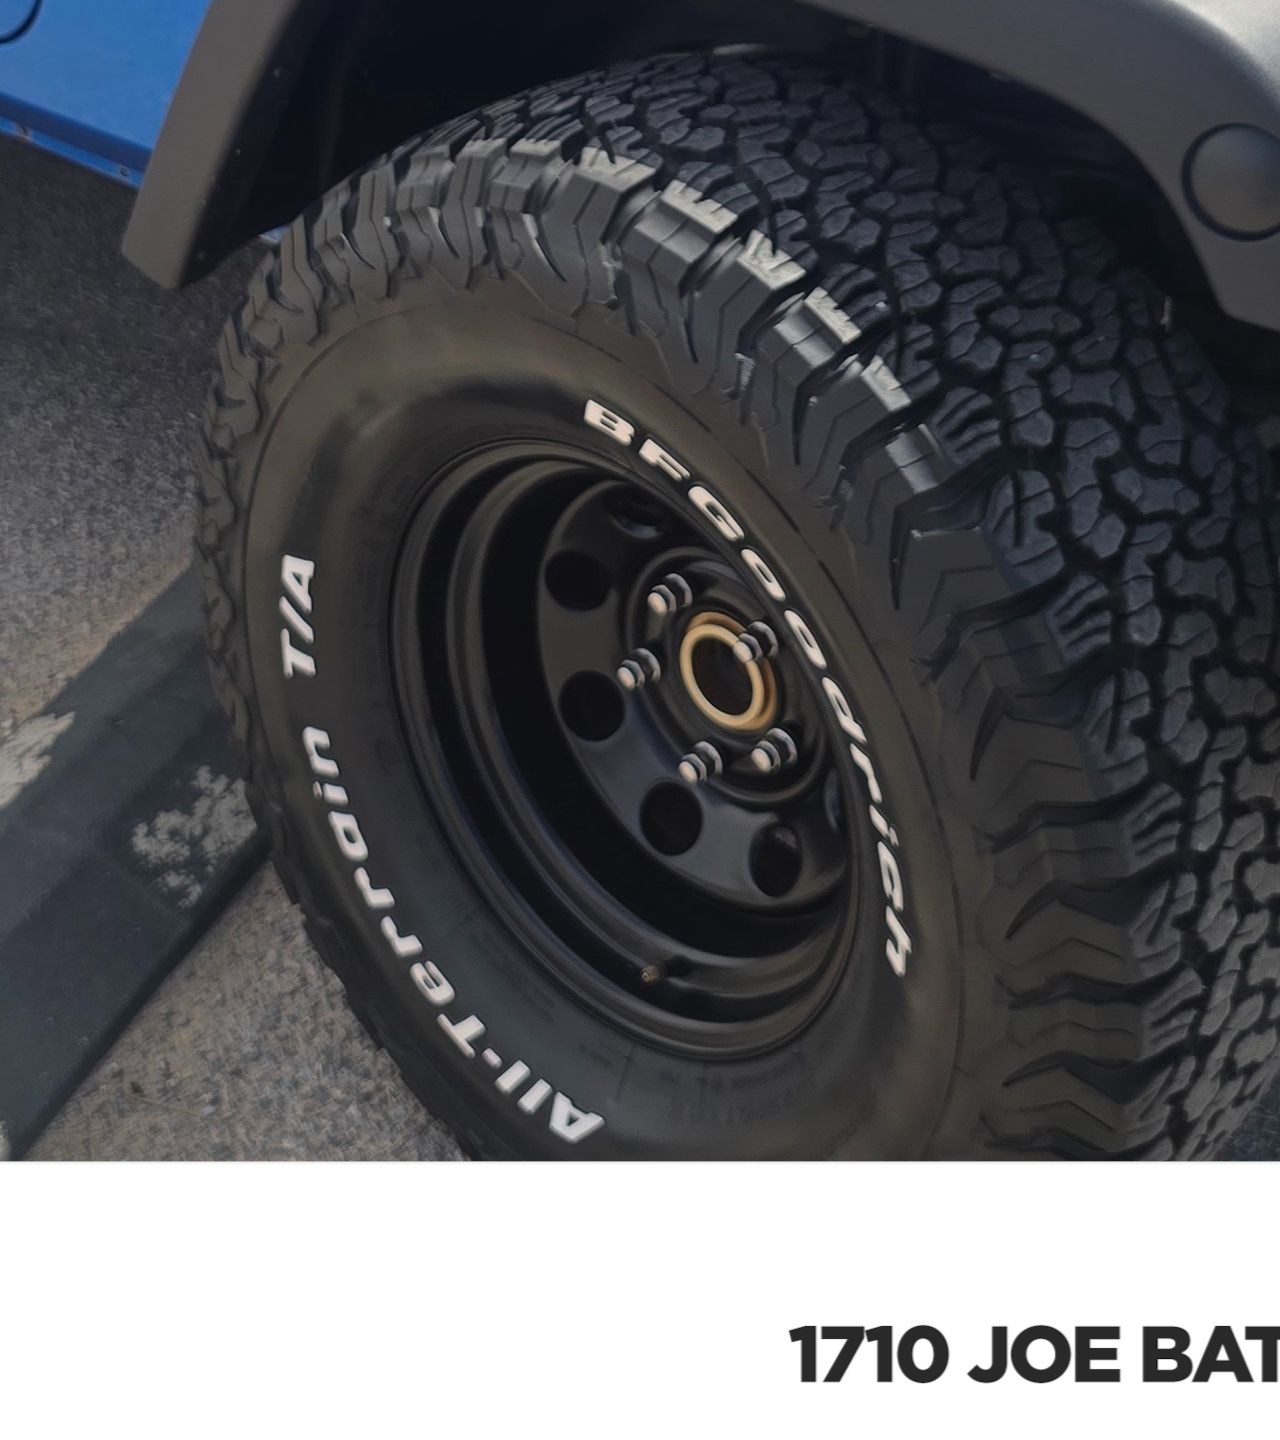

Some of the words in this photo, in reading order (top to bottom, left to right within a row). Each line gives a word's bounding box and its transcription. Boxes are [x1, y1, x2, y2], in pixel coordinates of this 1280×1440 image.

[279, 553, 317, 680] T/A
[582, 397, 914, 979] BFGoodrich
[302, 725, 606, 1145] All-Terrain
